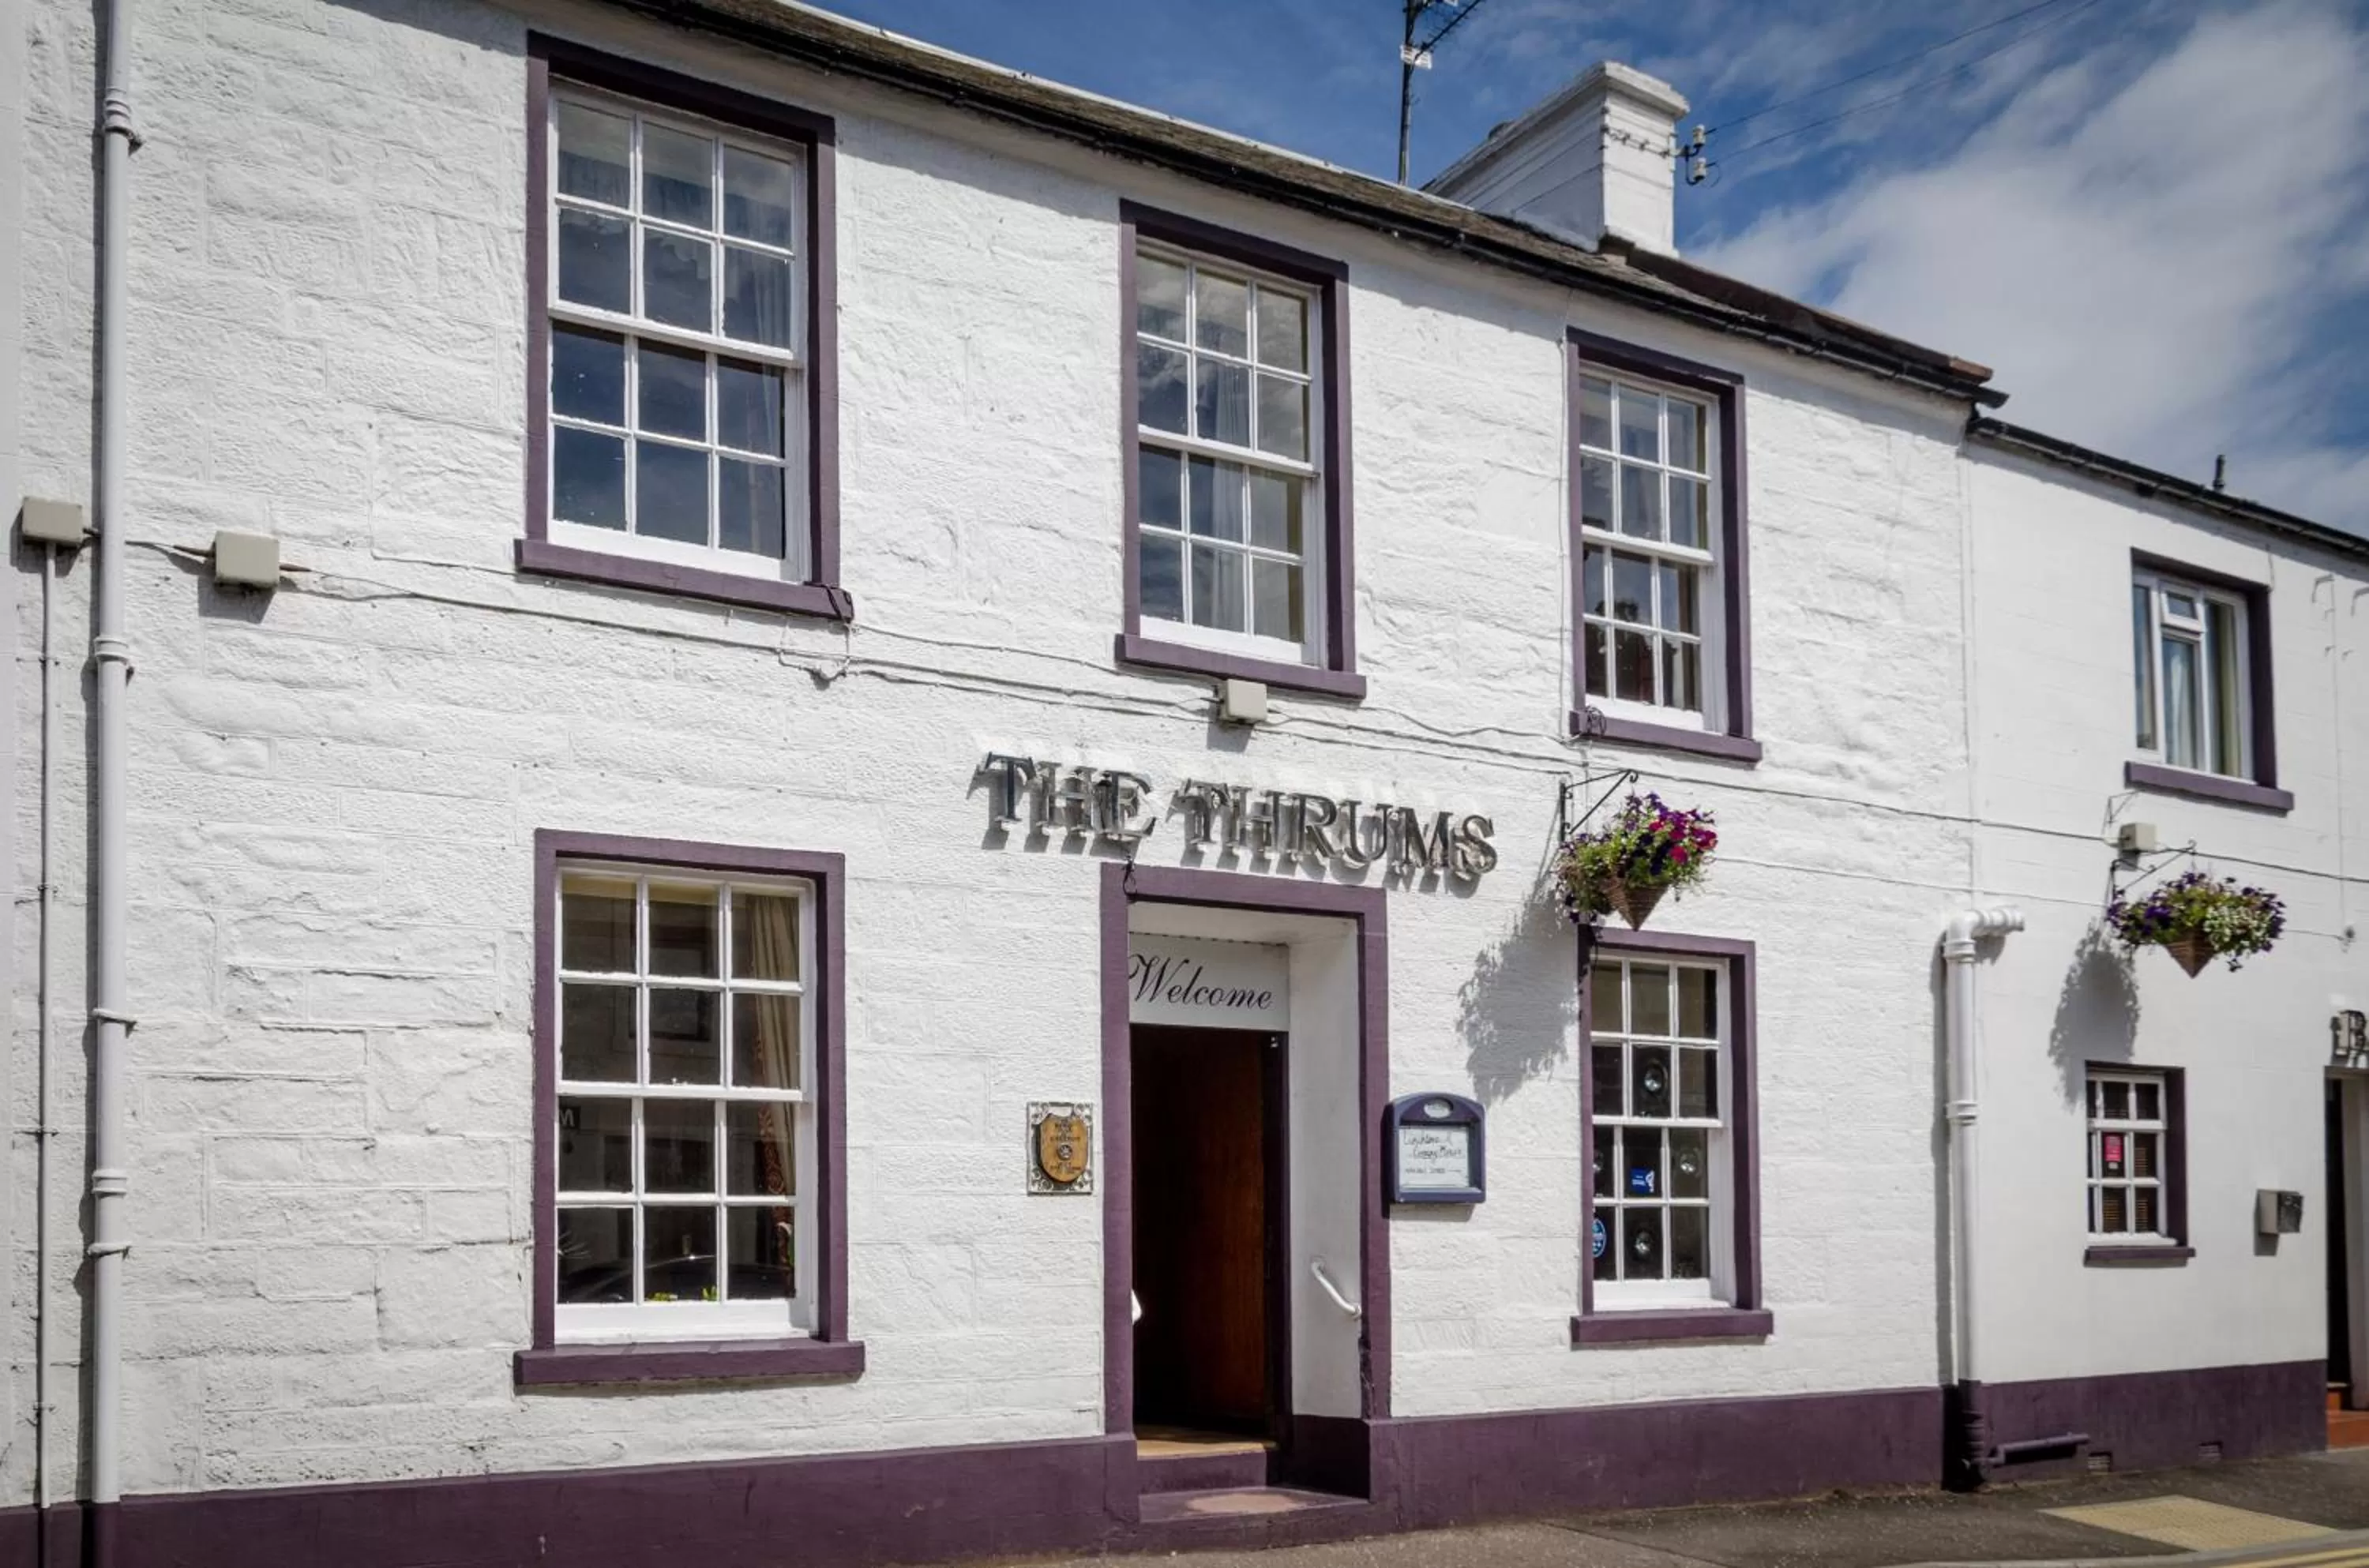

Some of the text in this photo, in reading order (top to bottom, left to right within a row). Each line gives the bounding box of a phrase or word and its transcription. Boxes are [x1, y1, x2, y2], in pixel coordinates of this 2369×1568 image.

[985, 752, 1498, 874] THE THRUMS
[1128, 953, 1274, 1010] Welcome
